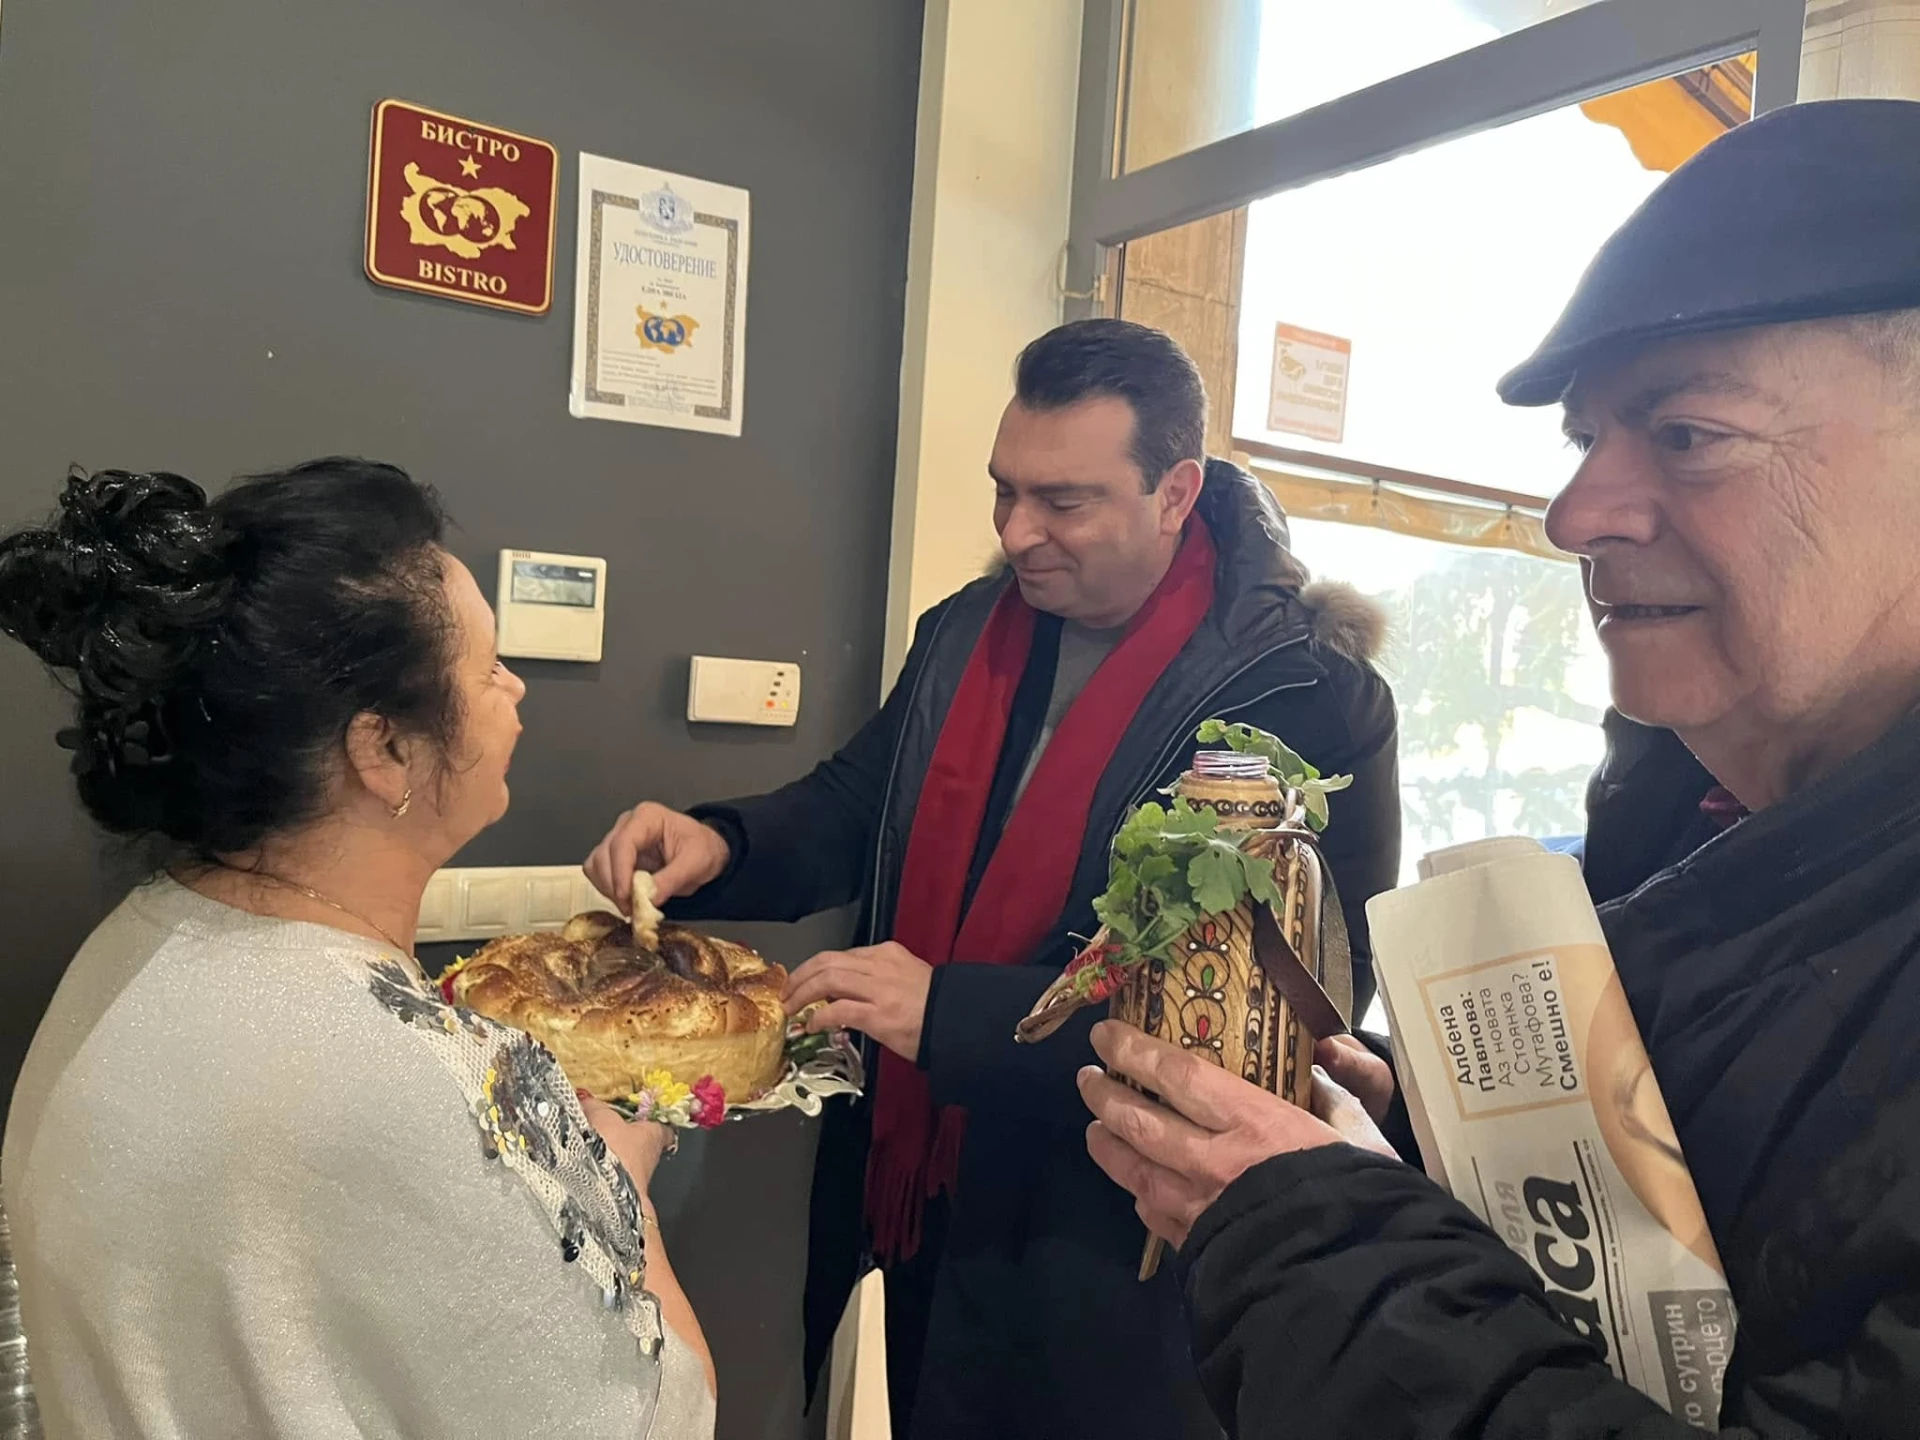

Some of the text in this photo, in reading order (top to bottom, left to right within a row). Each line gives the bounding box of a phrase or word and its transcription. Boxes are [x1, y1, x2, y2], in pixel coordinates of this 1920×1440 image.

[421, 120, 520, 162] БИСТРО
[419, 259, 507, 294] BISTRO
[613, 241, 717, 279] УДОСТОВЕРЕНИЕ
[1440, 1005, 1475, 1086] Албена
[1460, 991, 1496, 1092] Павлова:
[1479, 988, 1515, 1087] Аз новата
[1500, 991, 1530, 1074] Стоянка
[1512, 973, 1555, 1087] Мутафова?
[1532, 961, 1578, 1091] Смешно е!
[1665, 1304, 1700, 1393] сутрин
